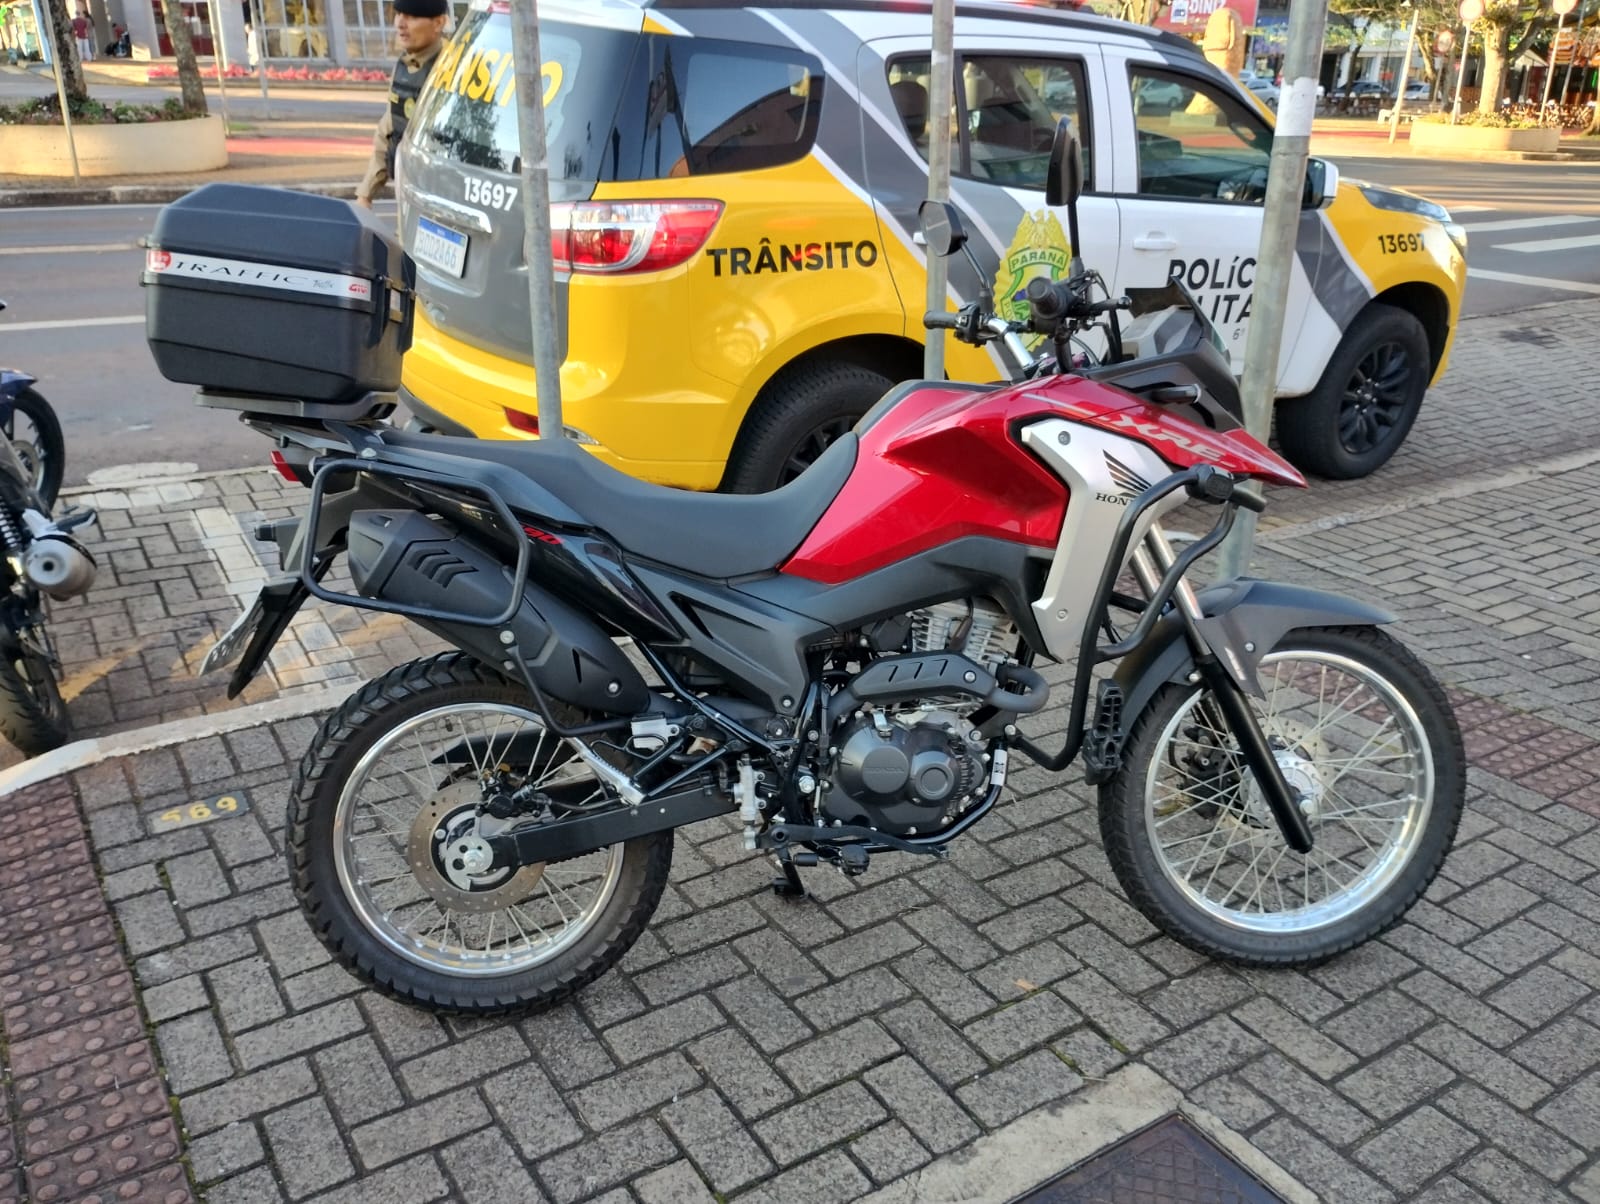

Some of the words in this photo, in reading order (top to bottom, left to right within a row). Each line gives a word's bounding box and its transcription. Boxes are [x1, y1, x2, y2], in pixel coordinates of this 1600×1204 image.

[464, 177, 518, 211] 13697
[706, 237, 877, 277] TRÂNSITO
[1377, 232, 1425, 255] 13697
[1166, 255, 1257, 290] POLÍC
[1111, 413, 1227, 463] XRE
[1095, 492, 1131, 507] HON
